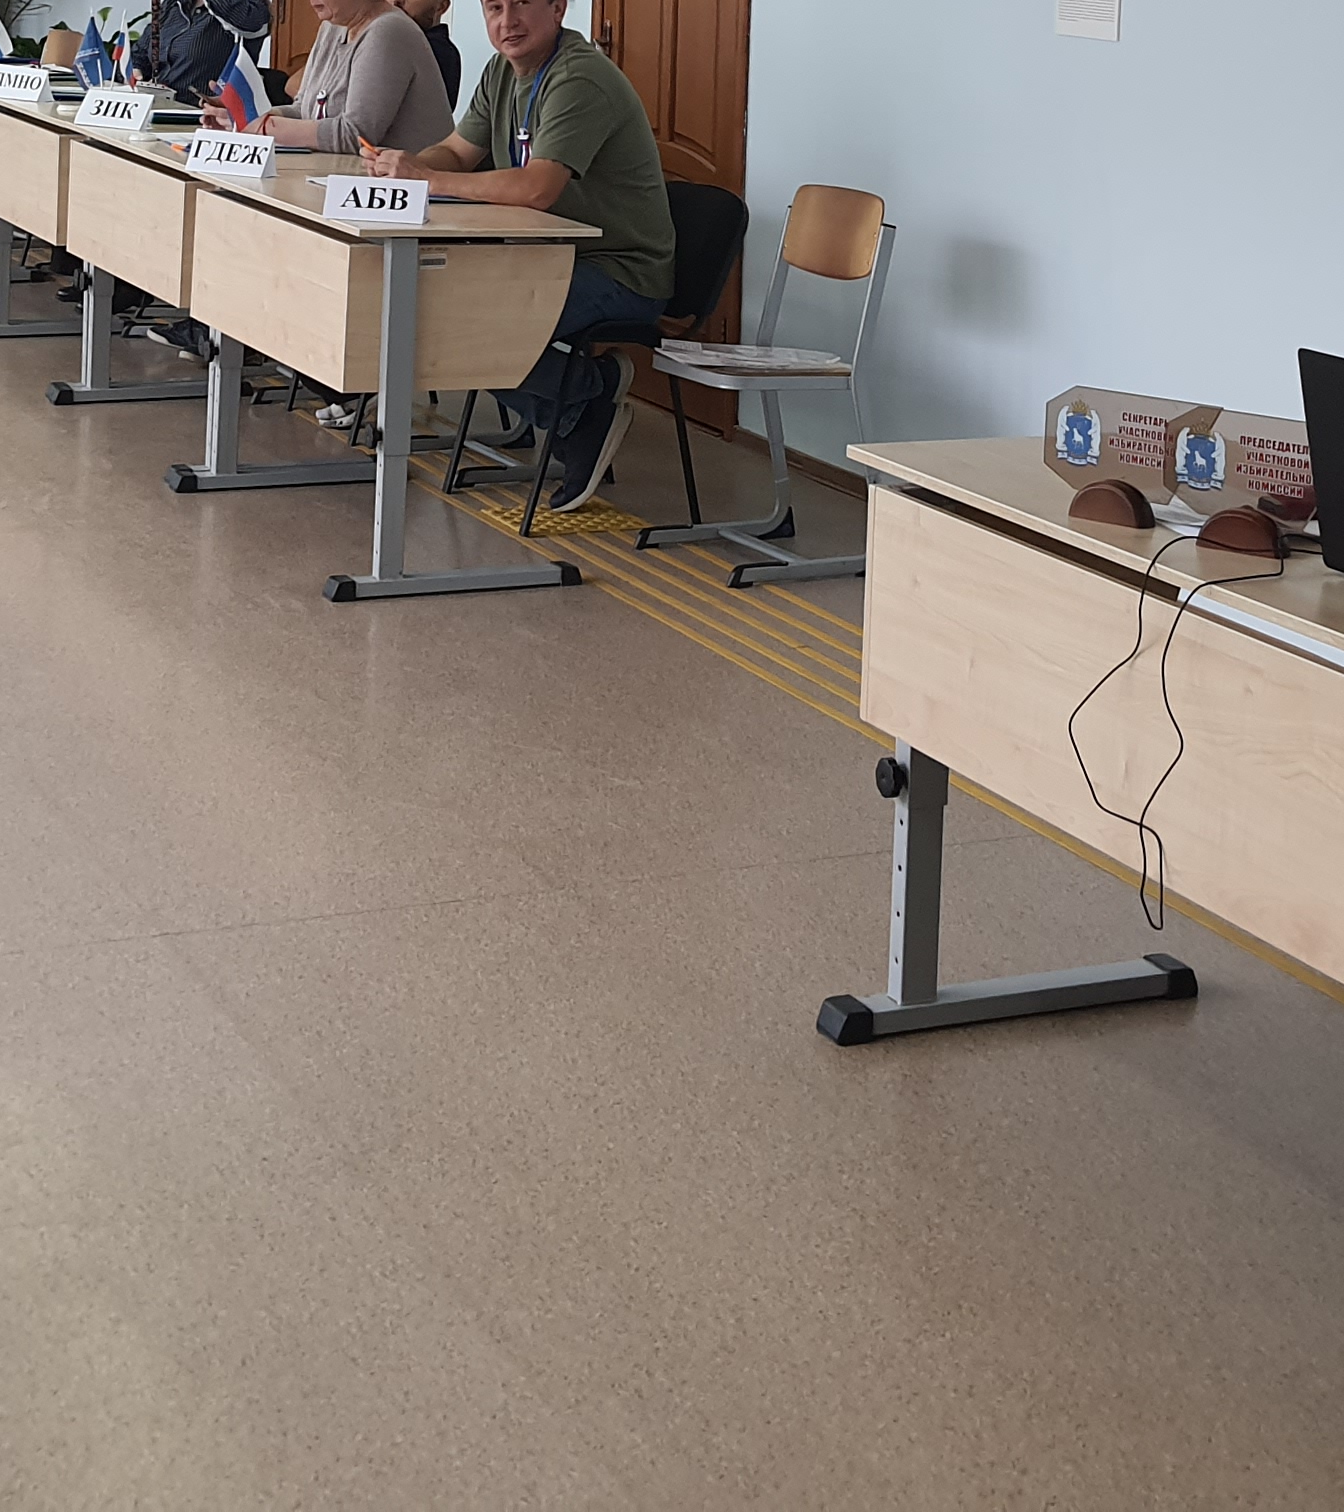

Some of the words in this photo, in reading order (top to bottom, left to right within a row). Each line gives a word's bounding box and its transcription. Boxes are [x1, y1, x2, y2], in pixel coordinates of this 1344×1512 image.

[89, 98, 139, 120] ЗИК
[191, 140, 269, 166] ГДЕЖ
[340, 186, 409, 211] АБВ
[1240, 435, 1309, 455] ПРЕДСЕДАТЕЛ
[1236, 464, 1312, 484] ИЗБИРАТЕЛЬНО
[1248, 480, 1303, 497] КОМИССИИ
